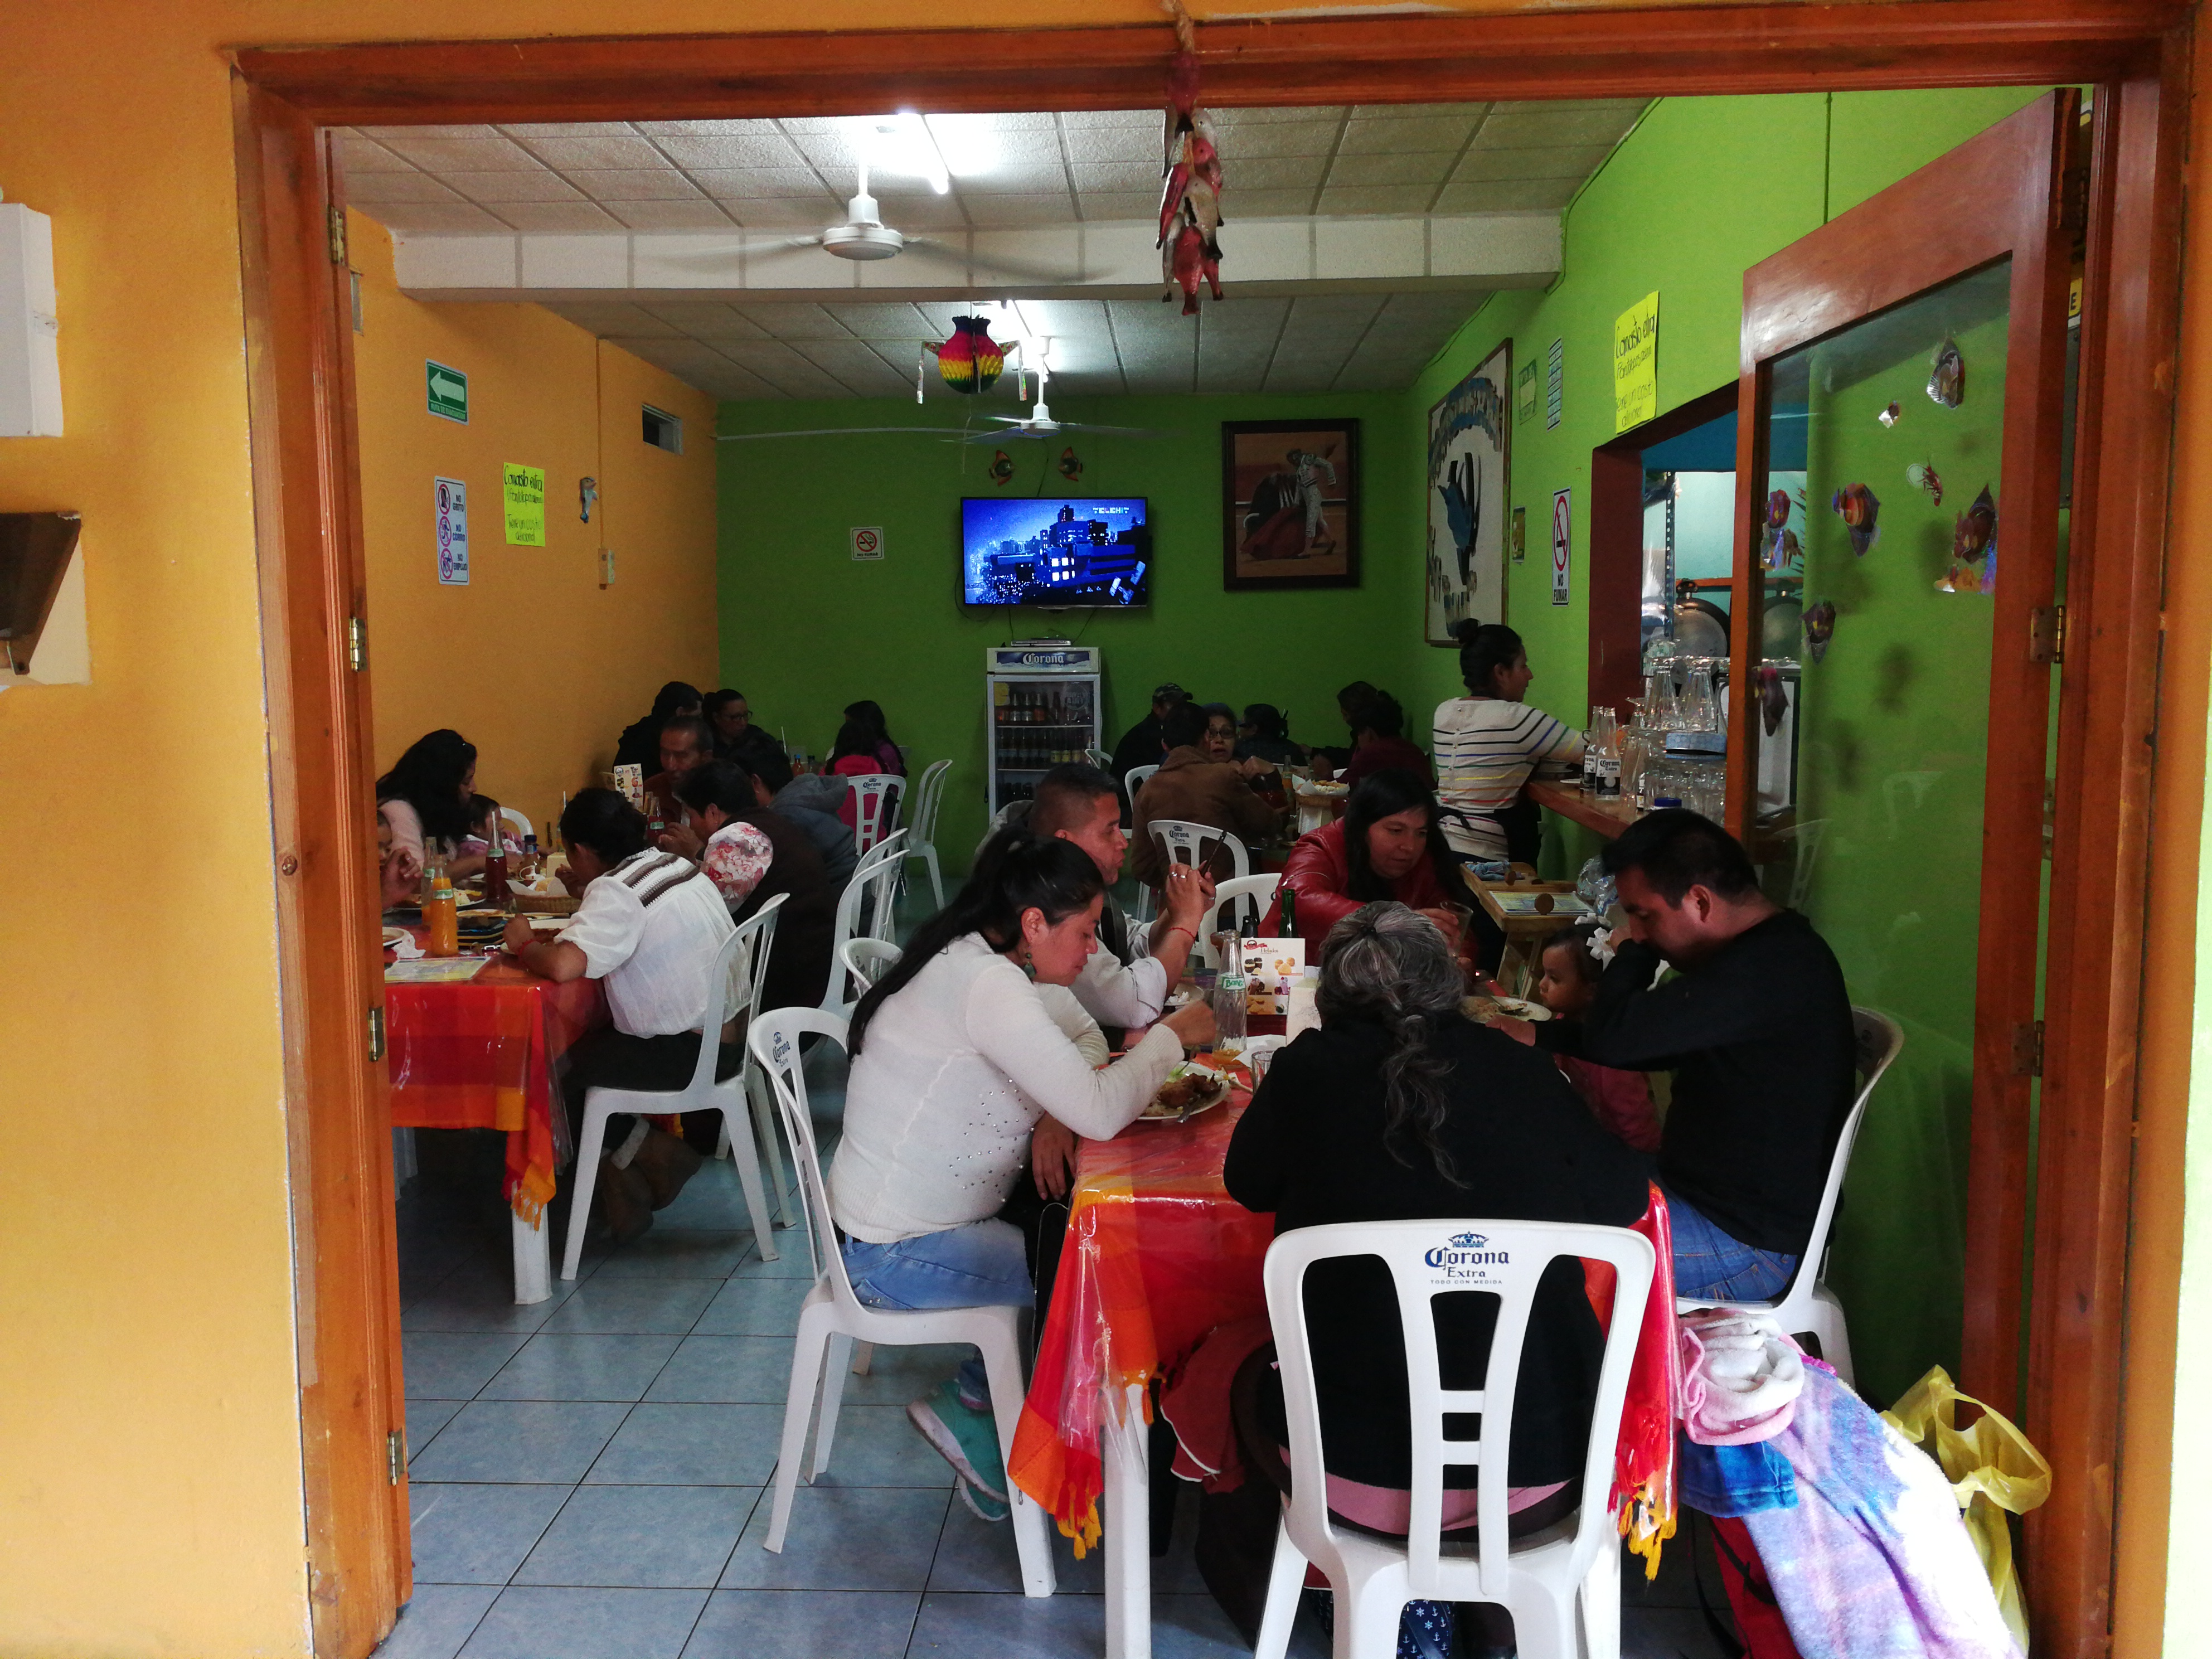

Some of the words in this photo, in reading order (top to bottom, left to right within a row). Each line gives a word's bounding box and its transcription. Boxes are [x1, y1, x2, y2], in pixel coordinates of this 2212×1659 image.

[455, 494, 462, 503] NO
[453, 502, 464, 512] GRITO
[453, 532, 465, 542] CORRO
[457, 554, 463, 562] NO
[453, 562, 467, 571] EMPUJO
[1558, 573, 1564, 586] NO
[1553, 588, 1568, 602] FUMAR
[1022, 653, 1064, 667] Corona
[773, 1041, 790, 1063] Corona
[1424, 1246, 1510, 1270] Corona
[1447, 1267, 1486, 1278] Extra
